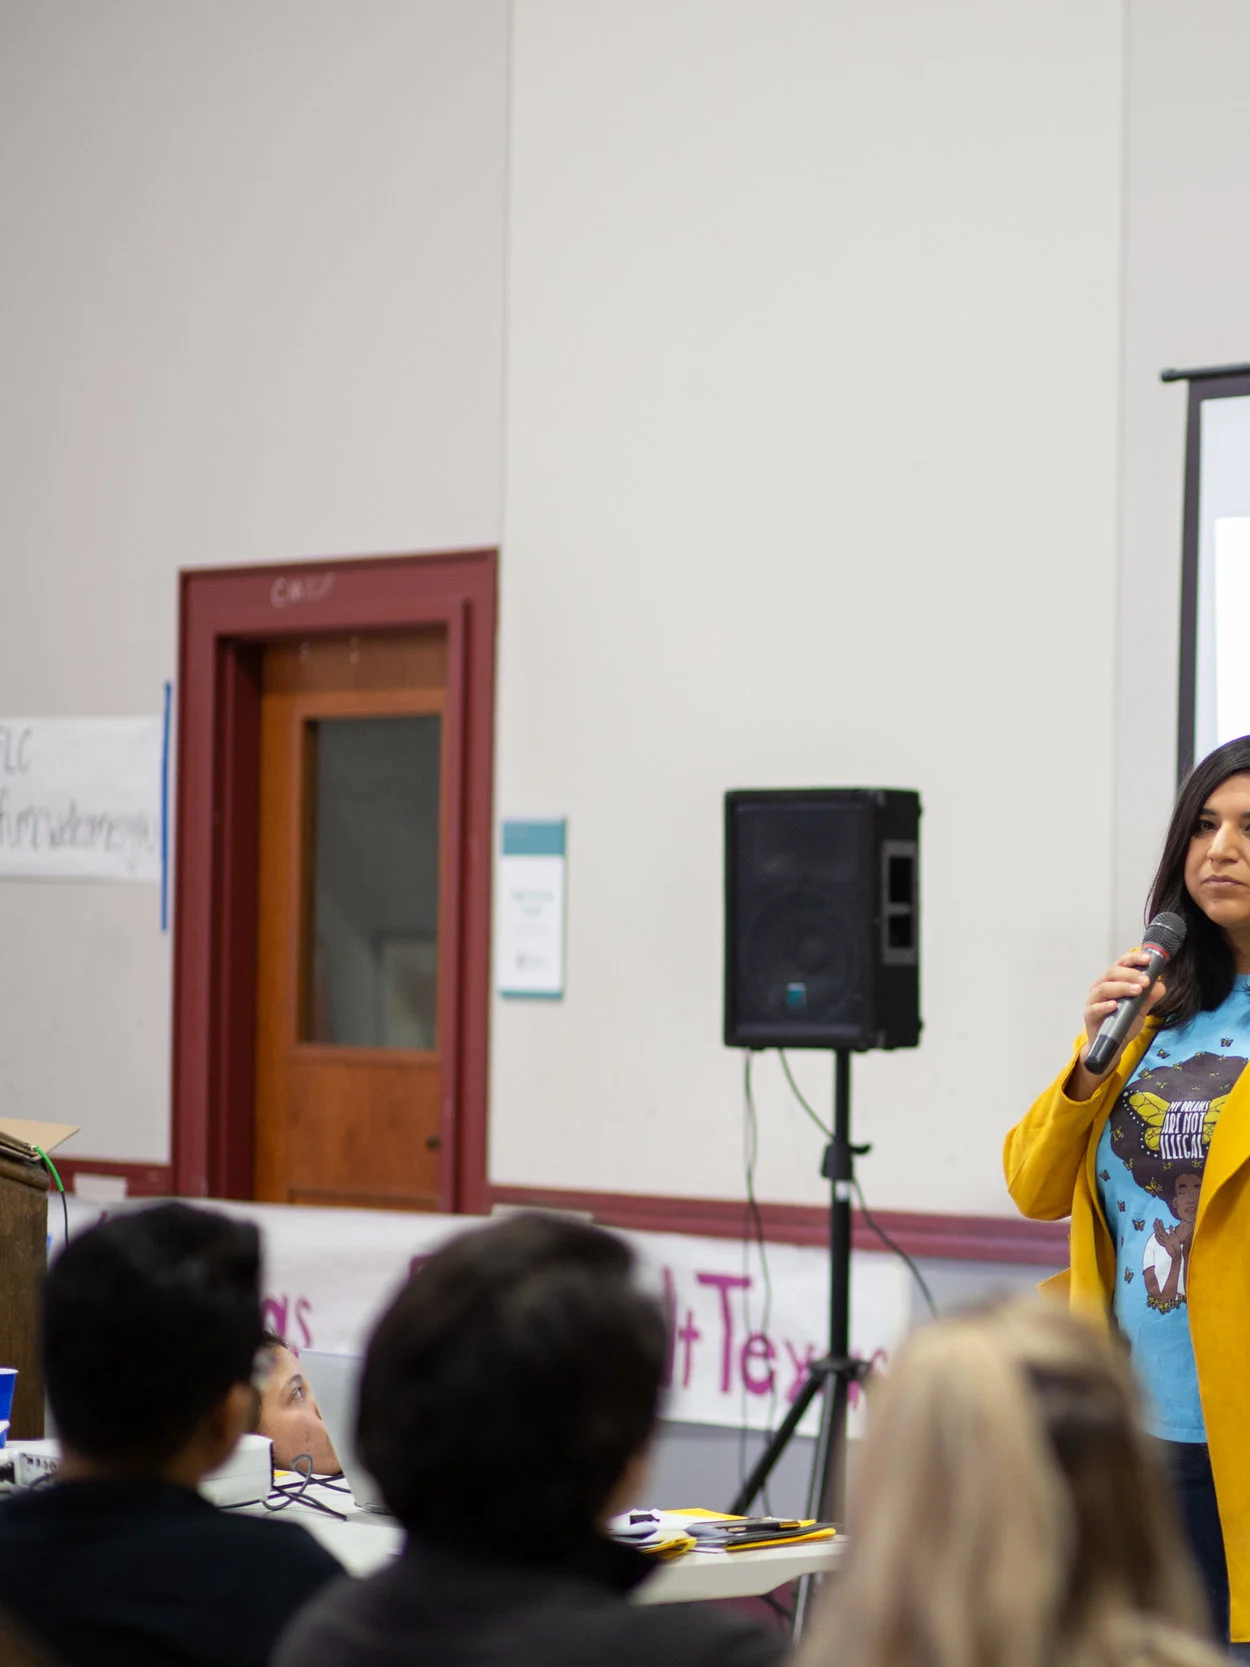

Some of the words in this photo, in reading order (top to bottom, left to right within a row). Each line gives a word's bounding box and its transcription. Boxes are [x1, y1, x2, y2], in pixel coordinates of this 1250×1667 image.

[1168, 1101, 1183, 1112] MY
[1161, 1112, 1181, 1134] ARE
[1182, 1112, 1206, 1134] NOT
[1160, 1133, 1204, 1160] ILLEGAL
